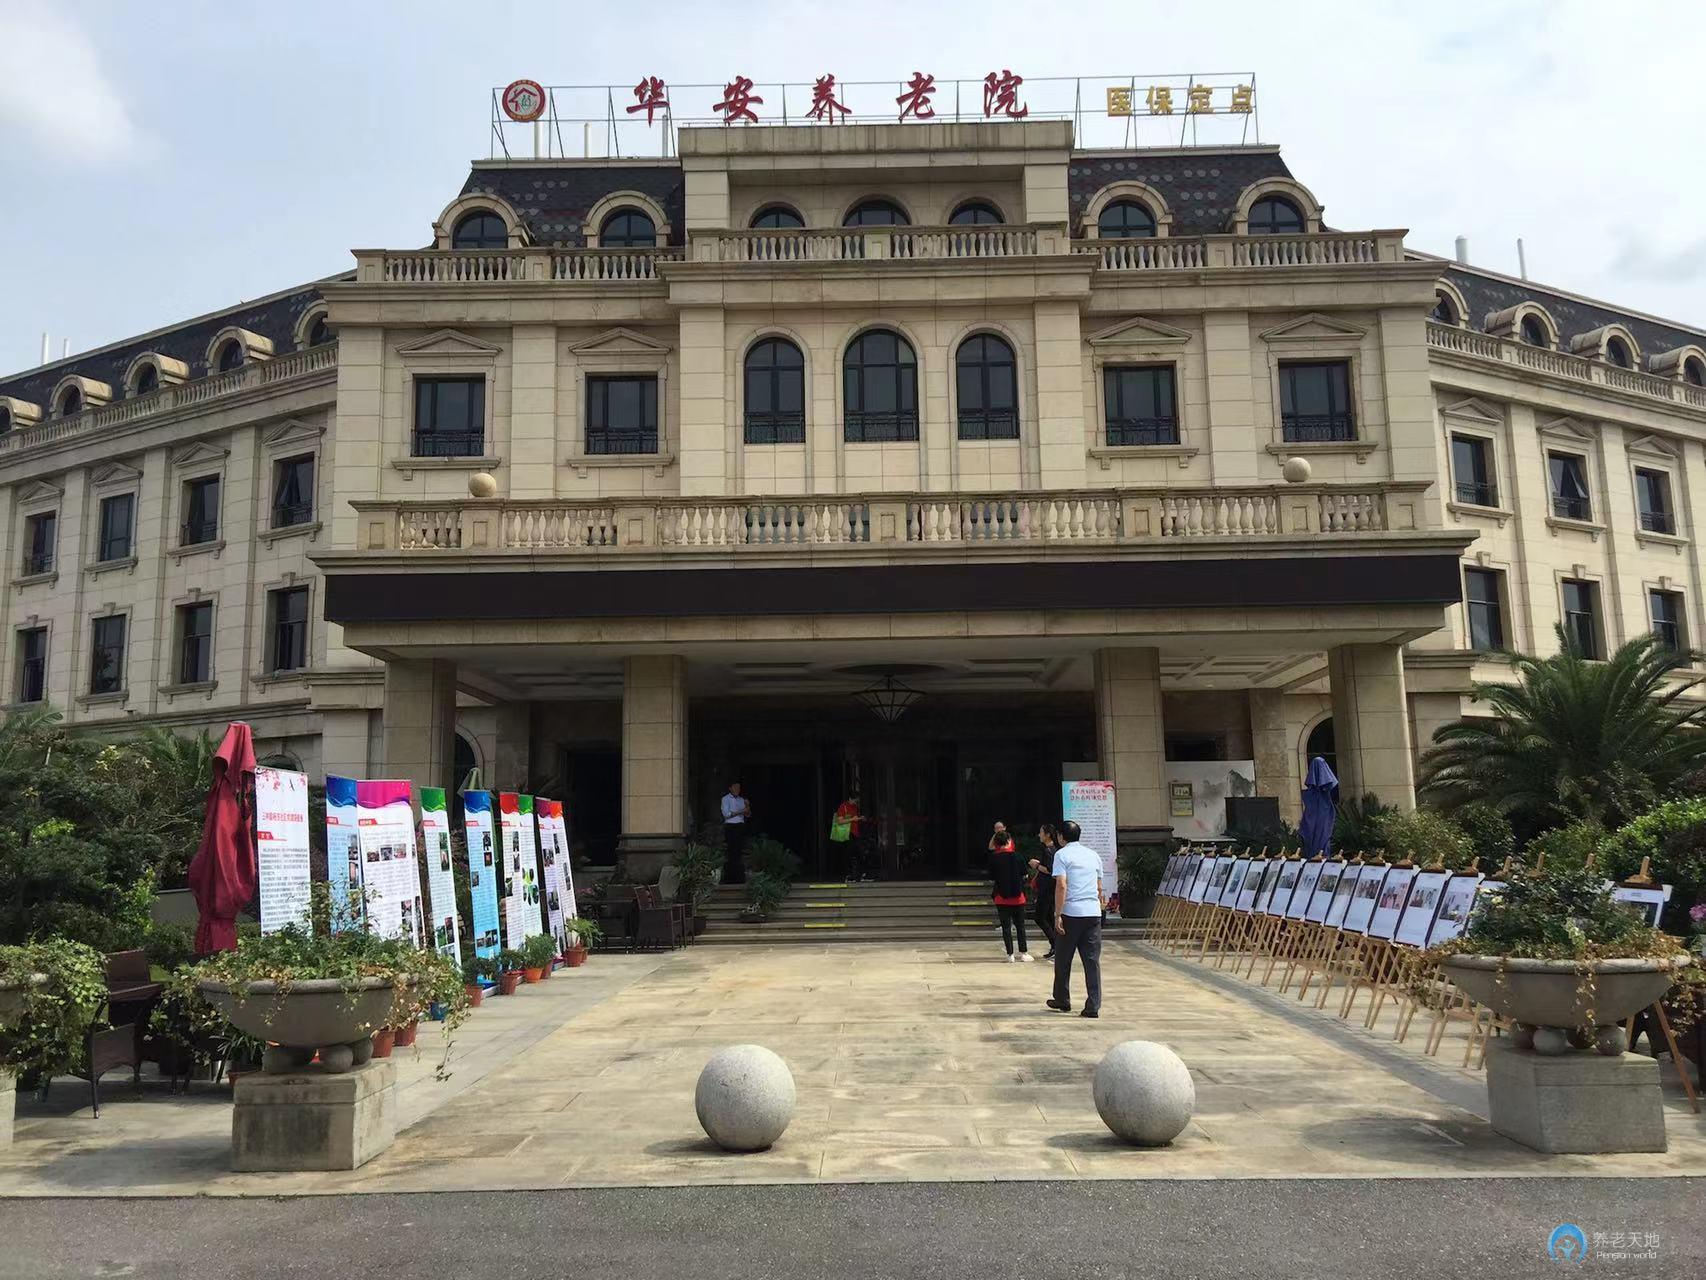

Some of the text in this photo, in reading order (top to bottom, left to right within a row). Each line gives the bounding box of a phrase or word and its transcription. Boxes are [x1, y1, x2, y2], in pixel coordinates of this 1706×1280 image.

[626, 70, 1029, 127] 华安养老院
[1106, 84, 1253, 116] 医保定点
